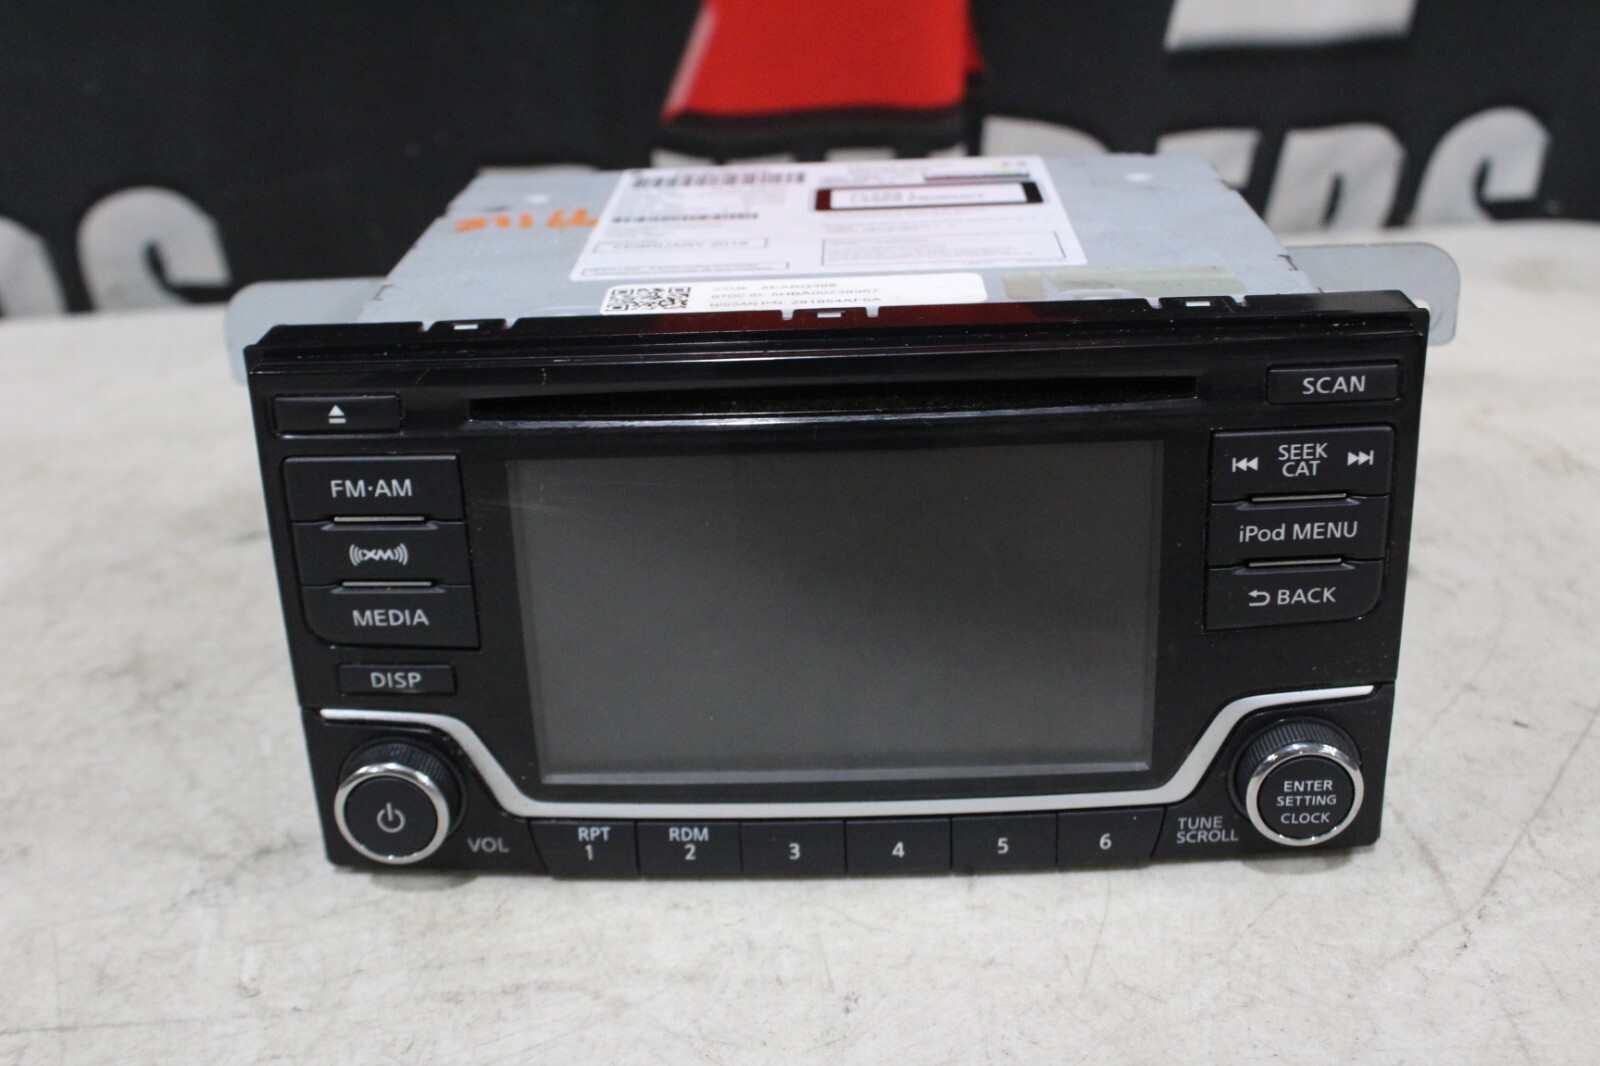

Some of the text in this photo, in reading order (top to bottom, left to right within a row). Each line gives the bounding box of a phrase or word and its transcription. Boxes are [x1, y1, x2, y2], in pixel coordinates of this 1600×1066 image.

[1302, 375, 1366, 395] SCAN
[1278, 442, 1328, 460] SEEK
[1282, 461, 1321, 477] CAT
[1239, 520, 1358, 543] iPod MENU
[1277, 587, 1336, 605] BACK
[352, 608, 430, 627] MEDIA
[370, 671, 422, 689] DISP
[1283, 779, 1333, 793] ENTER
[1276, 794, 1337, 807] SETTING
[1177, 815, 1222, 829] TUNE
[1280, 812, 1330, 825] CLOCK
[577, 826, 611, 842] RPT
[668, 826, 709, 842] RDM
[1099, 833, 1112, 850] 6
[1176, 828, 1239, 844] SCROLL
[467, 836, 510, 853] VOL
[585, 844, 593, 861] 1
[684, 843, 696, 861] 2
[789, 842, 801, 860] 3
[892, 841, 905, 858] 4
[997, 837, 1009, 855] 5
